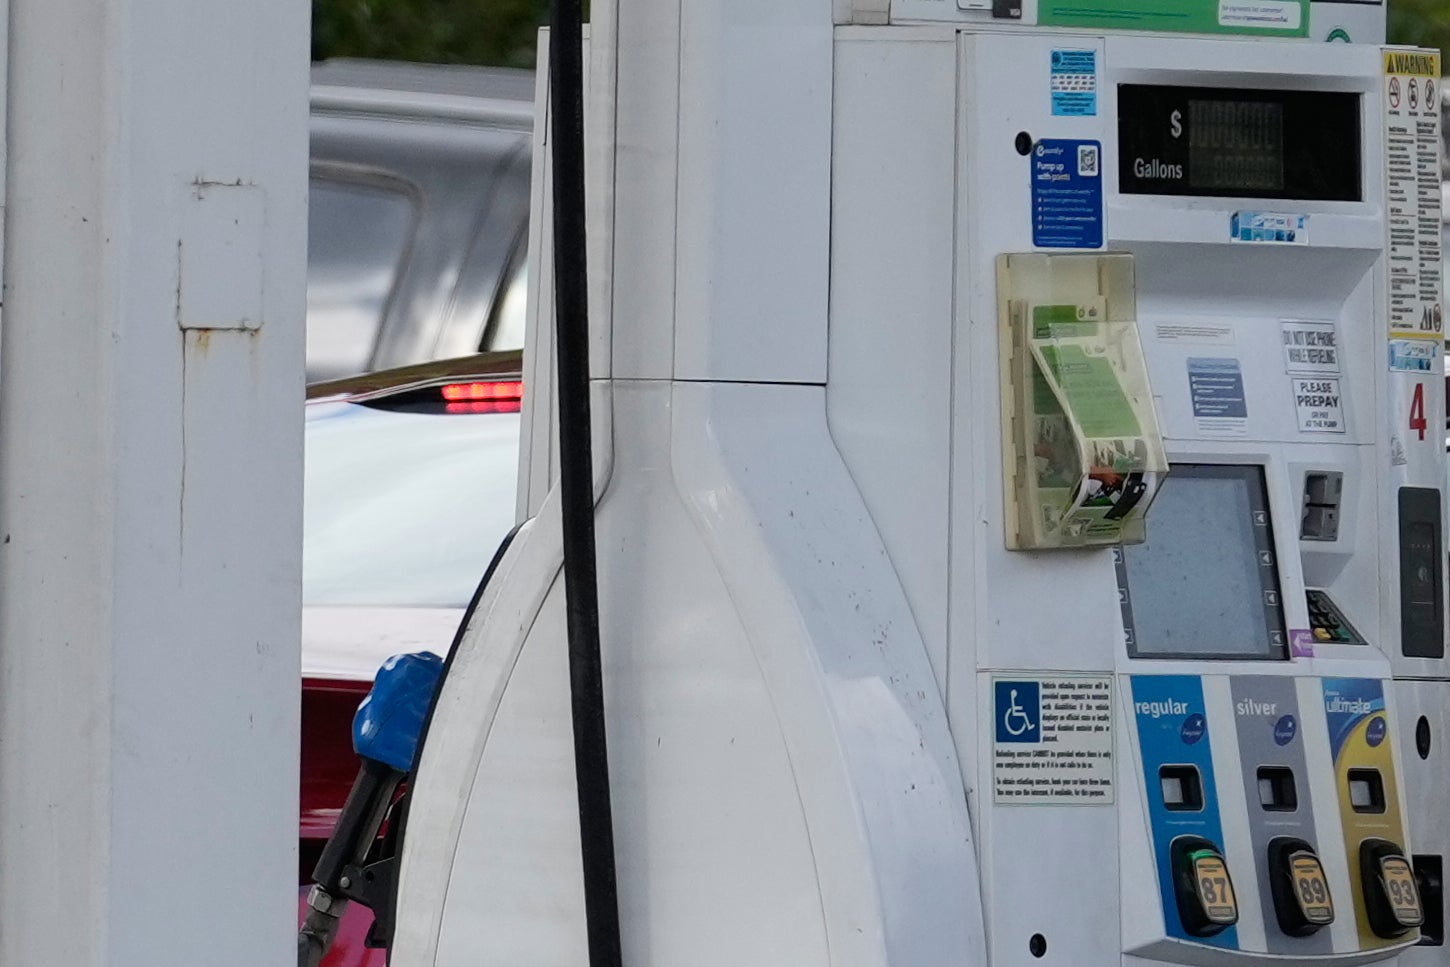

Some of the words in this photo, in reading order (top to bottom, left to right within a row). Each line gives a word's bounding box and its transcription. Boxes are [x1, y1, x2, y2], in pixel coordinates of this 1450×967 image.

[1395, 54, 1435, 76] WARNING
[1134, 157, 1183, 179] Gallons
[1300, 382, 1332, 393] PLEASE
[1297, 395, 1339, 408] PREPAY
[1409, 382, 1427, 441] 4
[1135, 697, 1189, 718] regular
[1237, 698, 1277, 717] silver
[1326, 697, 1371, 715] ultimate
[1201, 877, 1228, 904] 87
[1298, 877, 1326, 904] 89
[1389, 879, 1416, 905] 93
